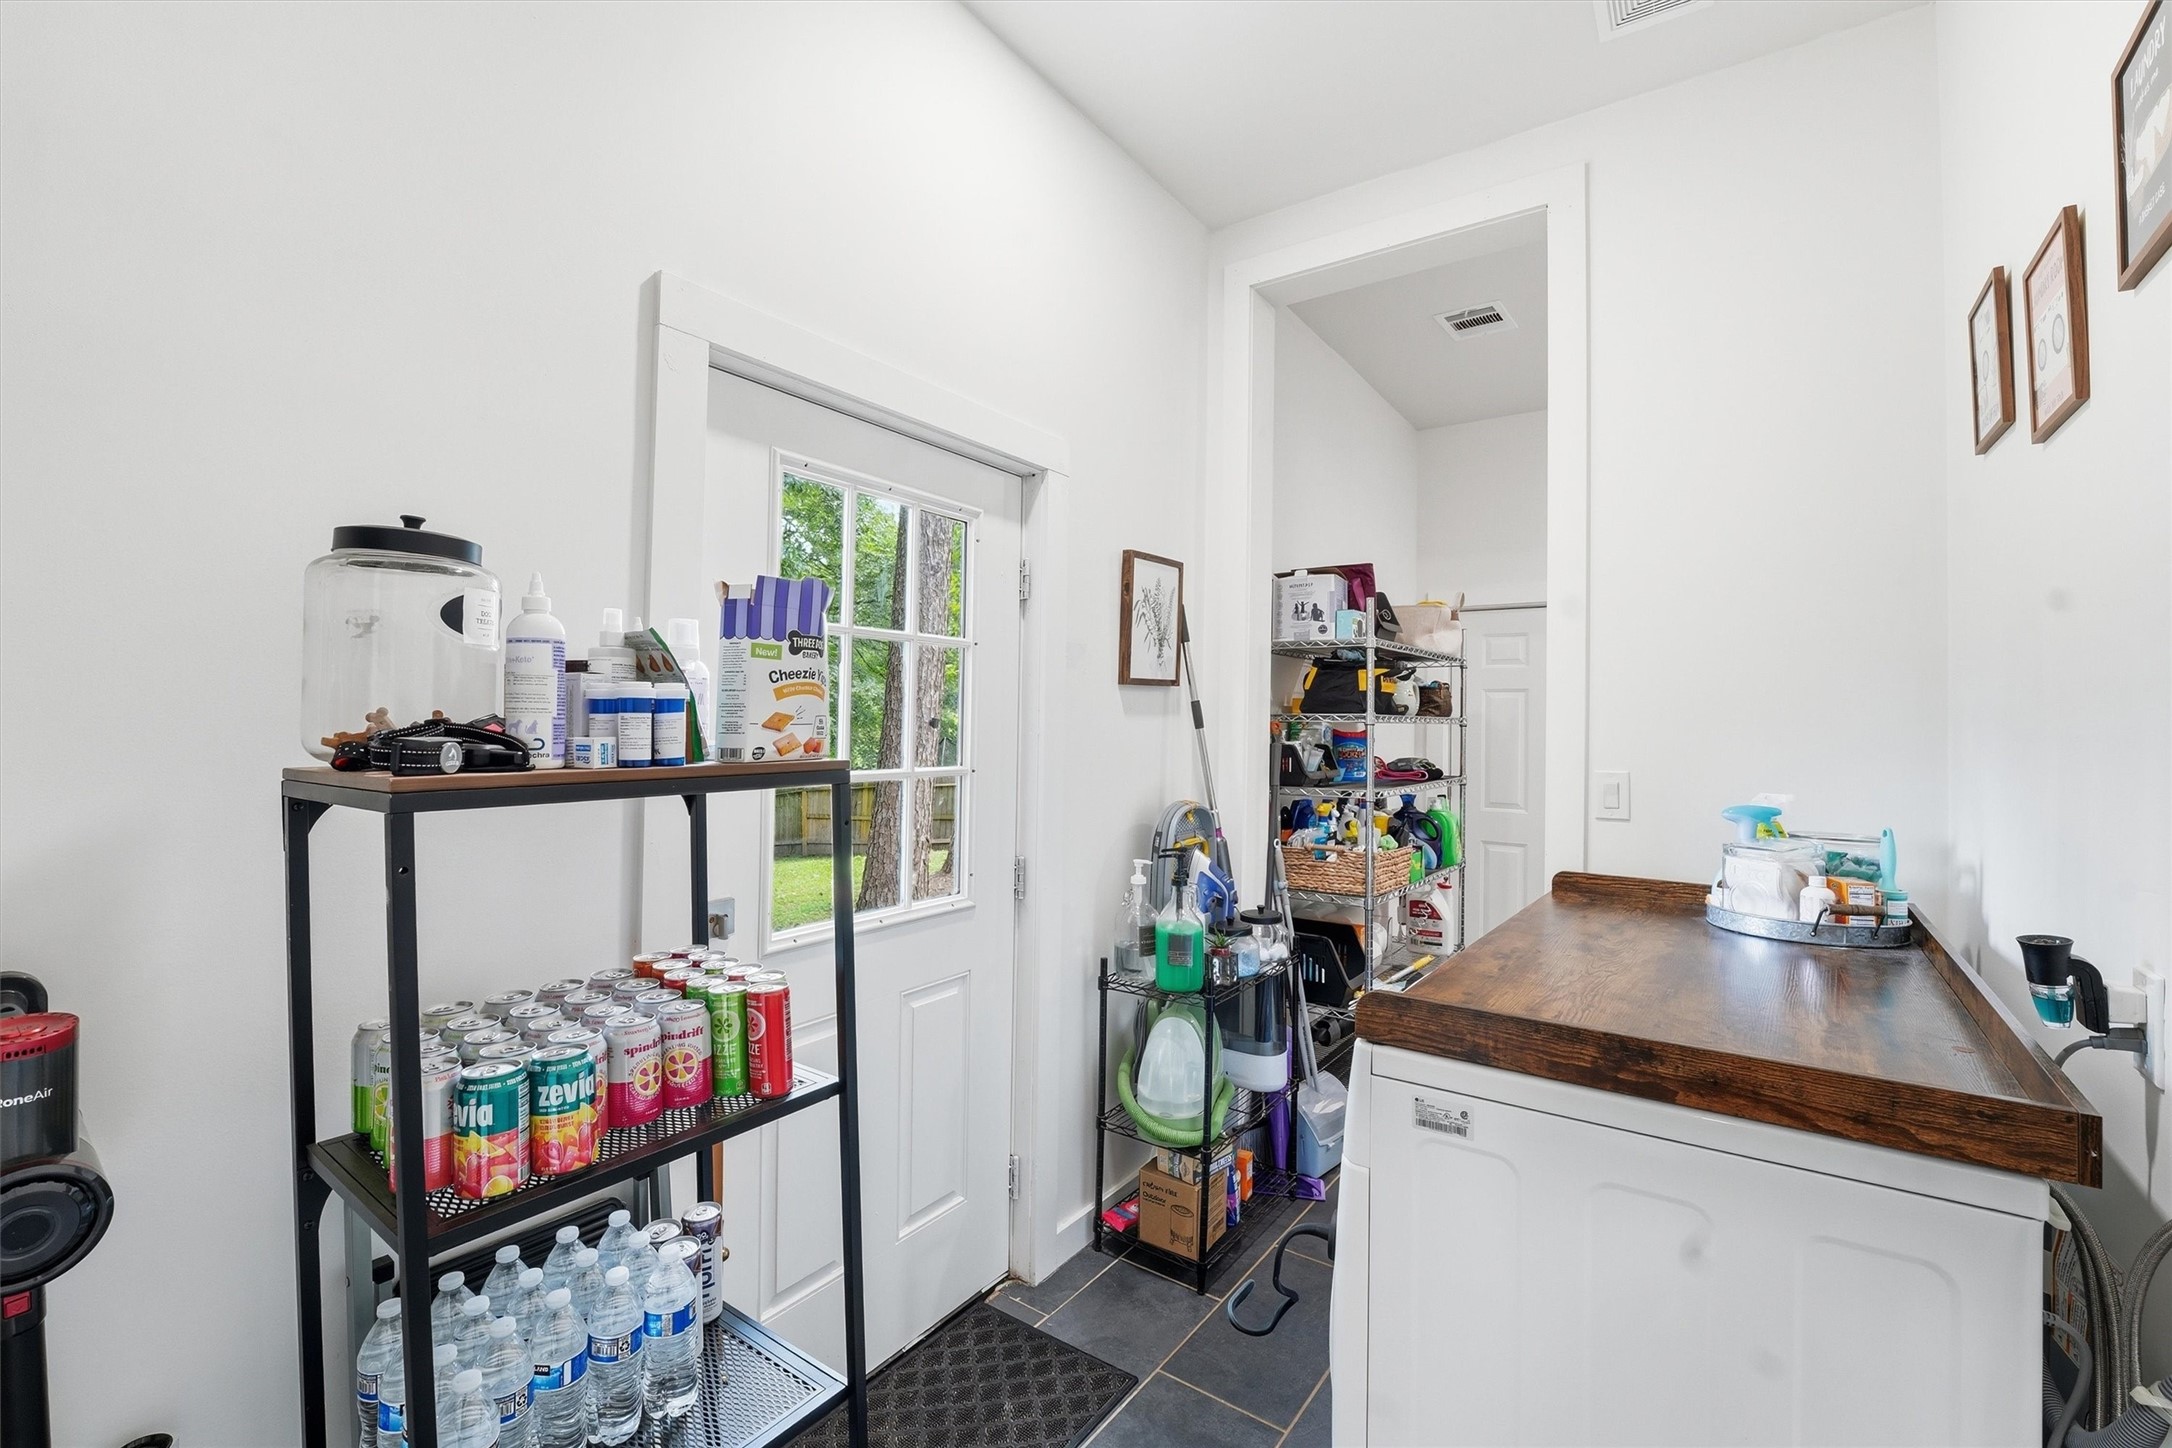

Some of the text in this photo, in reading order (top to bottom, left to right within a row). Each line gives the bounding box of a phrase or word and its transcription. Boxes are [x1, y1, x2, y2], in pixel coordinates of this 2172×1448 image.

[2130, 15, 2165, 100] LAUNDRY
[792, 637, 816, 649] THREE
[755, 647, 778, 658] New!
[768, 667, 816, 684] Cheezie
[660, 1025, 704, 1045] pindrift
[714, 1043, 737, 1056] IZZE
[537, 1071, 595, 1107] zevia
